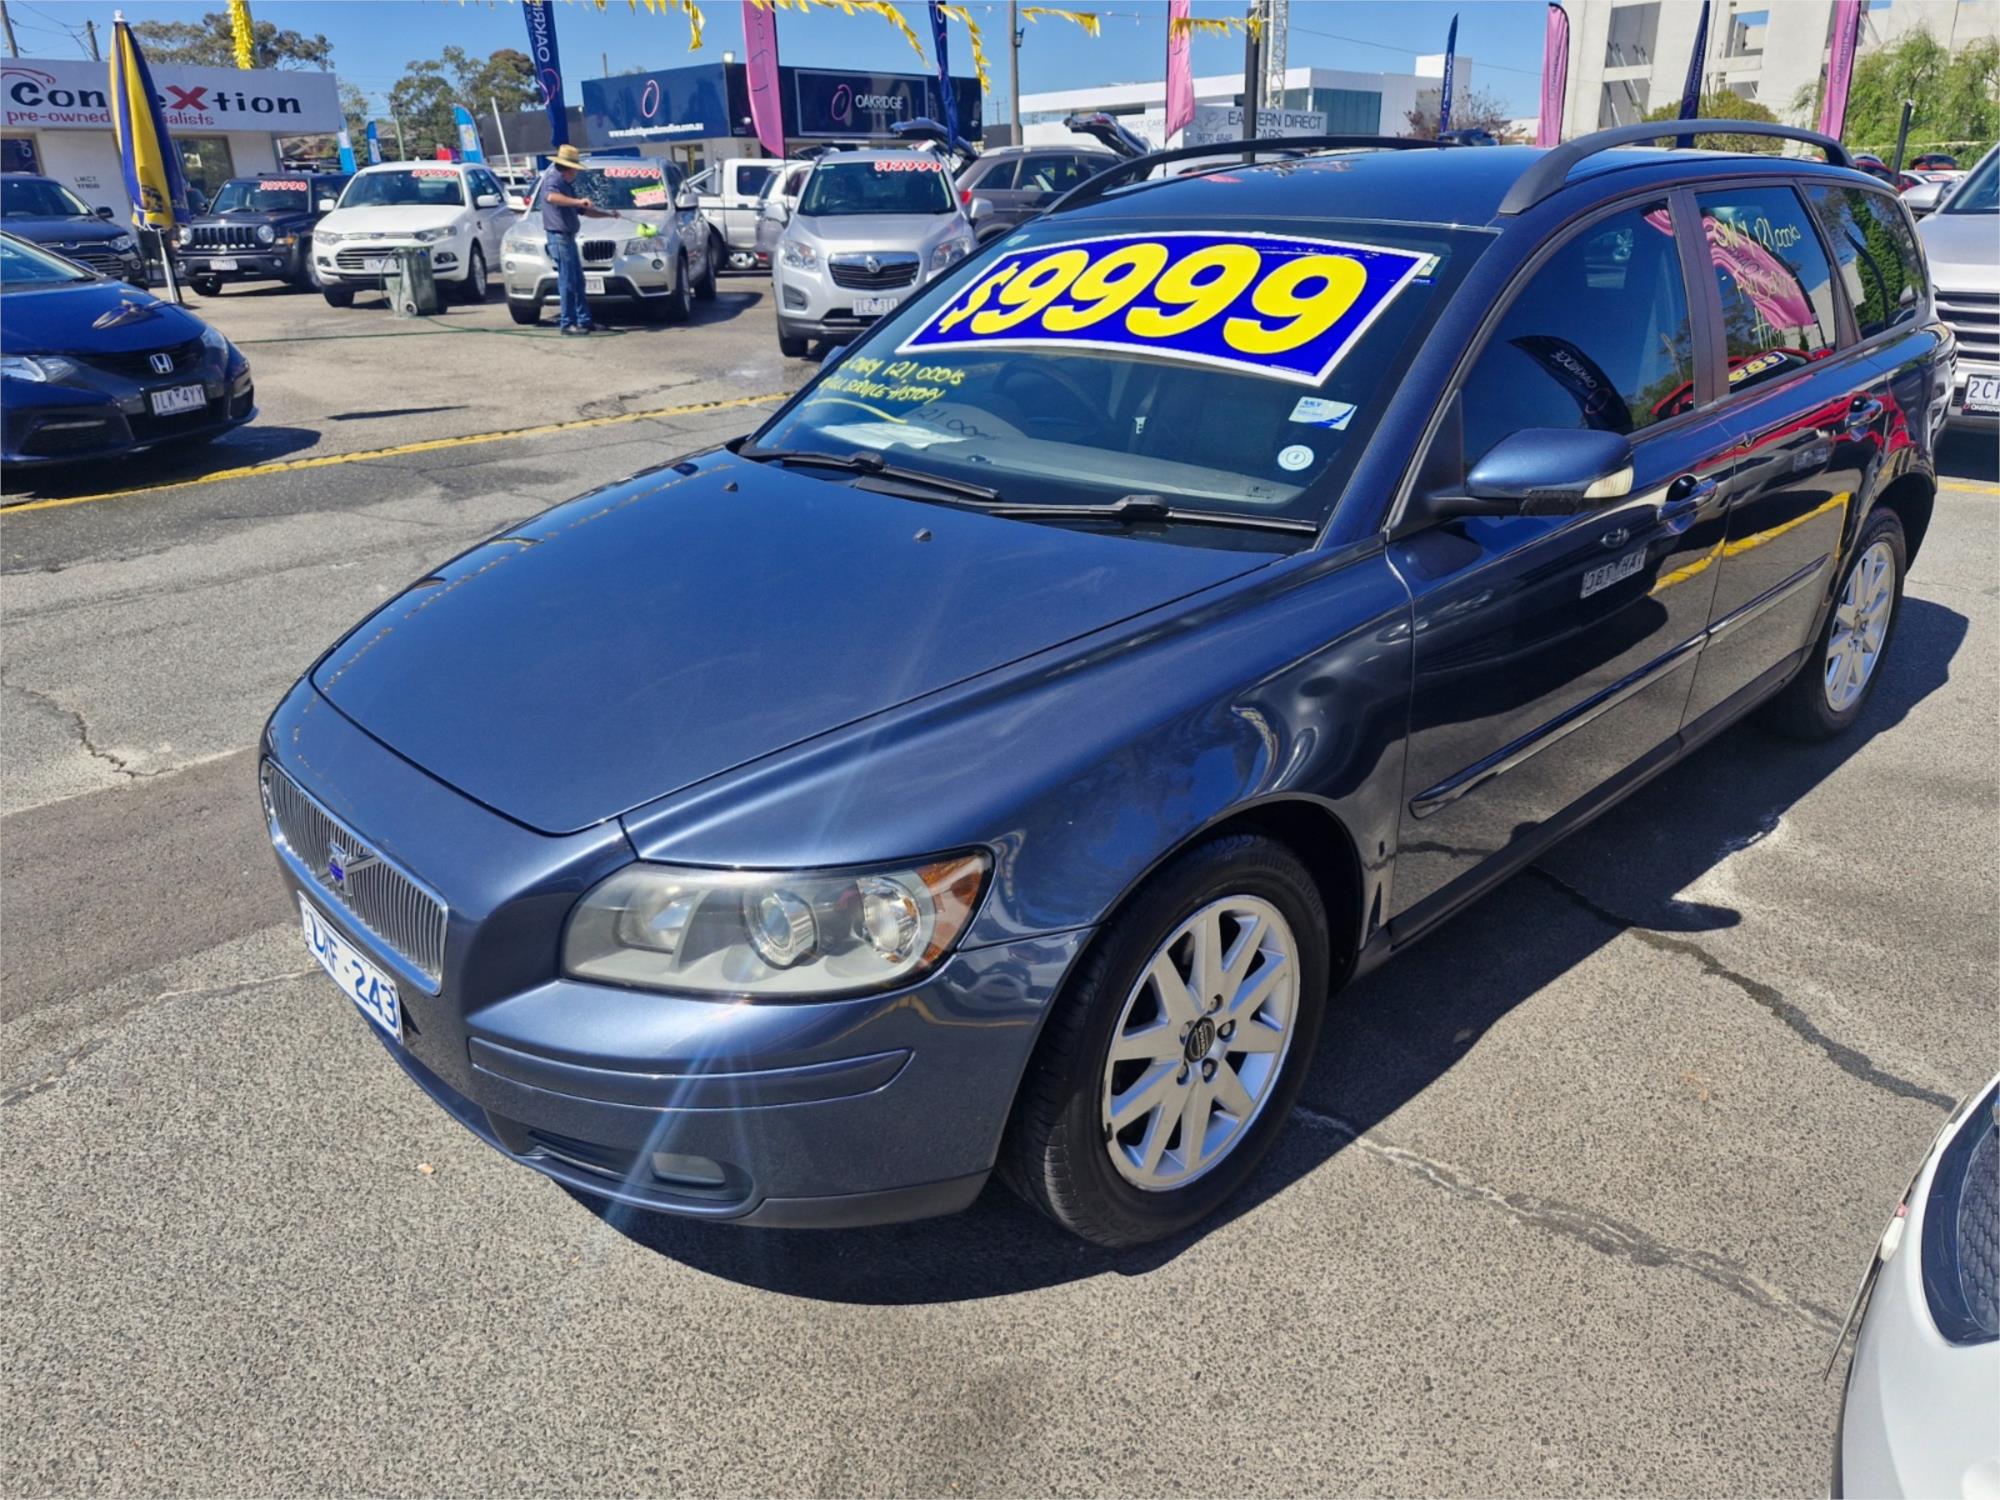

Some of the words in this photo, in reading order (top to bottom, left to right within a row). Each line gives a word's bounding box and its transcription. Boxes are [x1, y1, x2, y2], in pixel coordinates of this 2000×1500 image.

[855, 94, 903, 110] OAKRIDGE
[7, 109, 112, 125] pre-owned
[1284, 112, 1323, 130] DIRECT
[938, 242, 1369, 355] $9999
[843, 378, 889, 399] SERVICE
[886, 383, 947, 406] HISTORY
